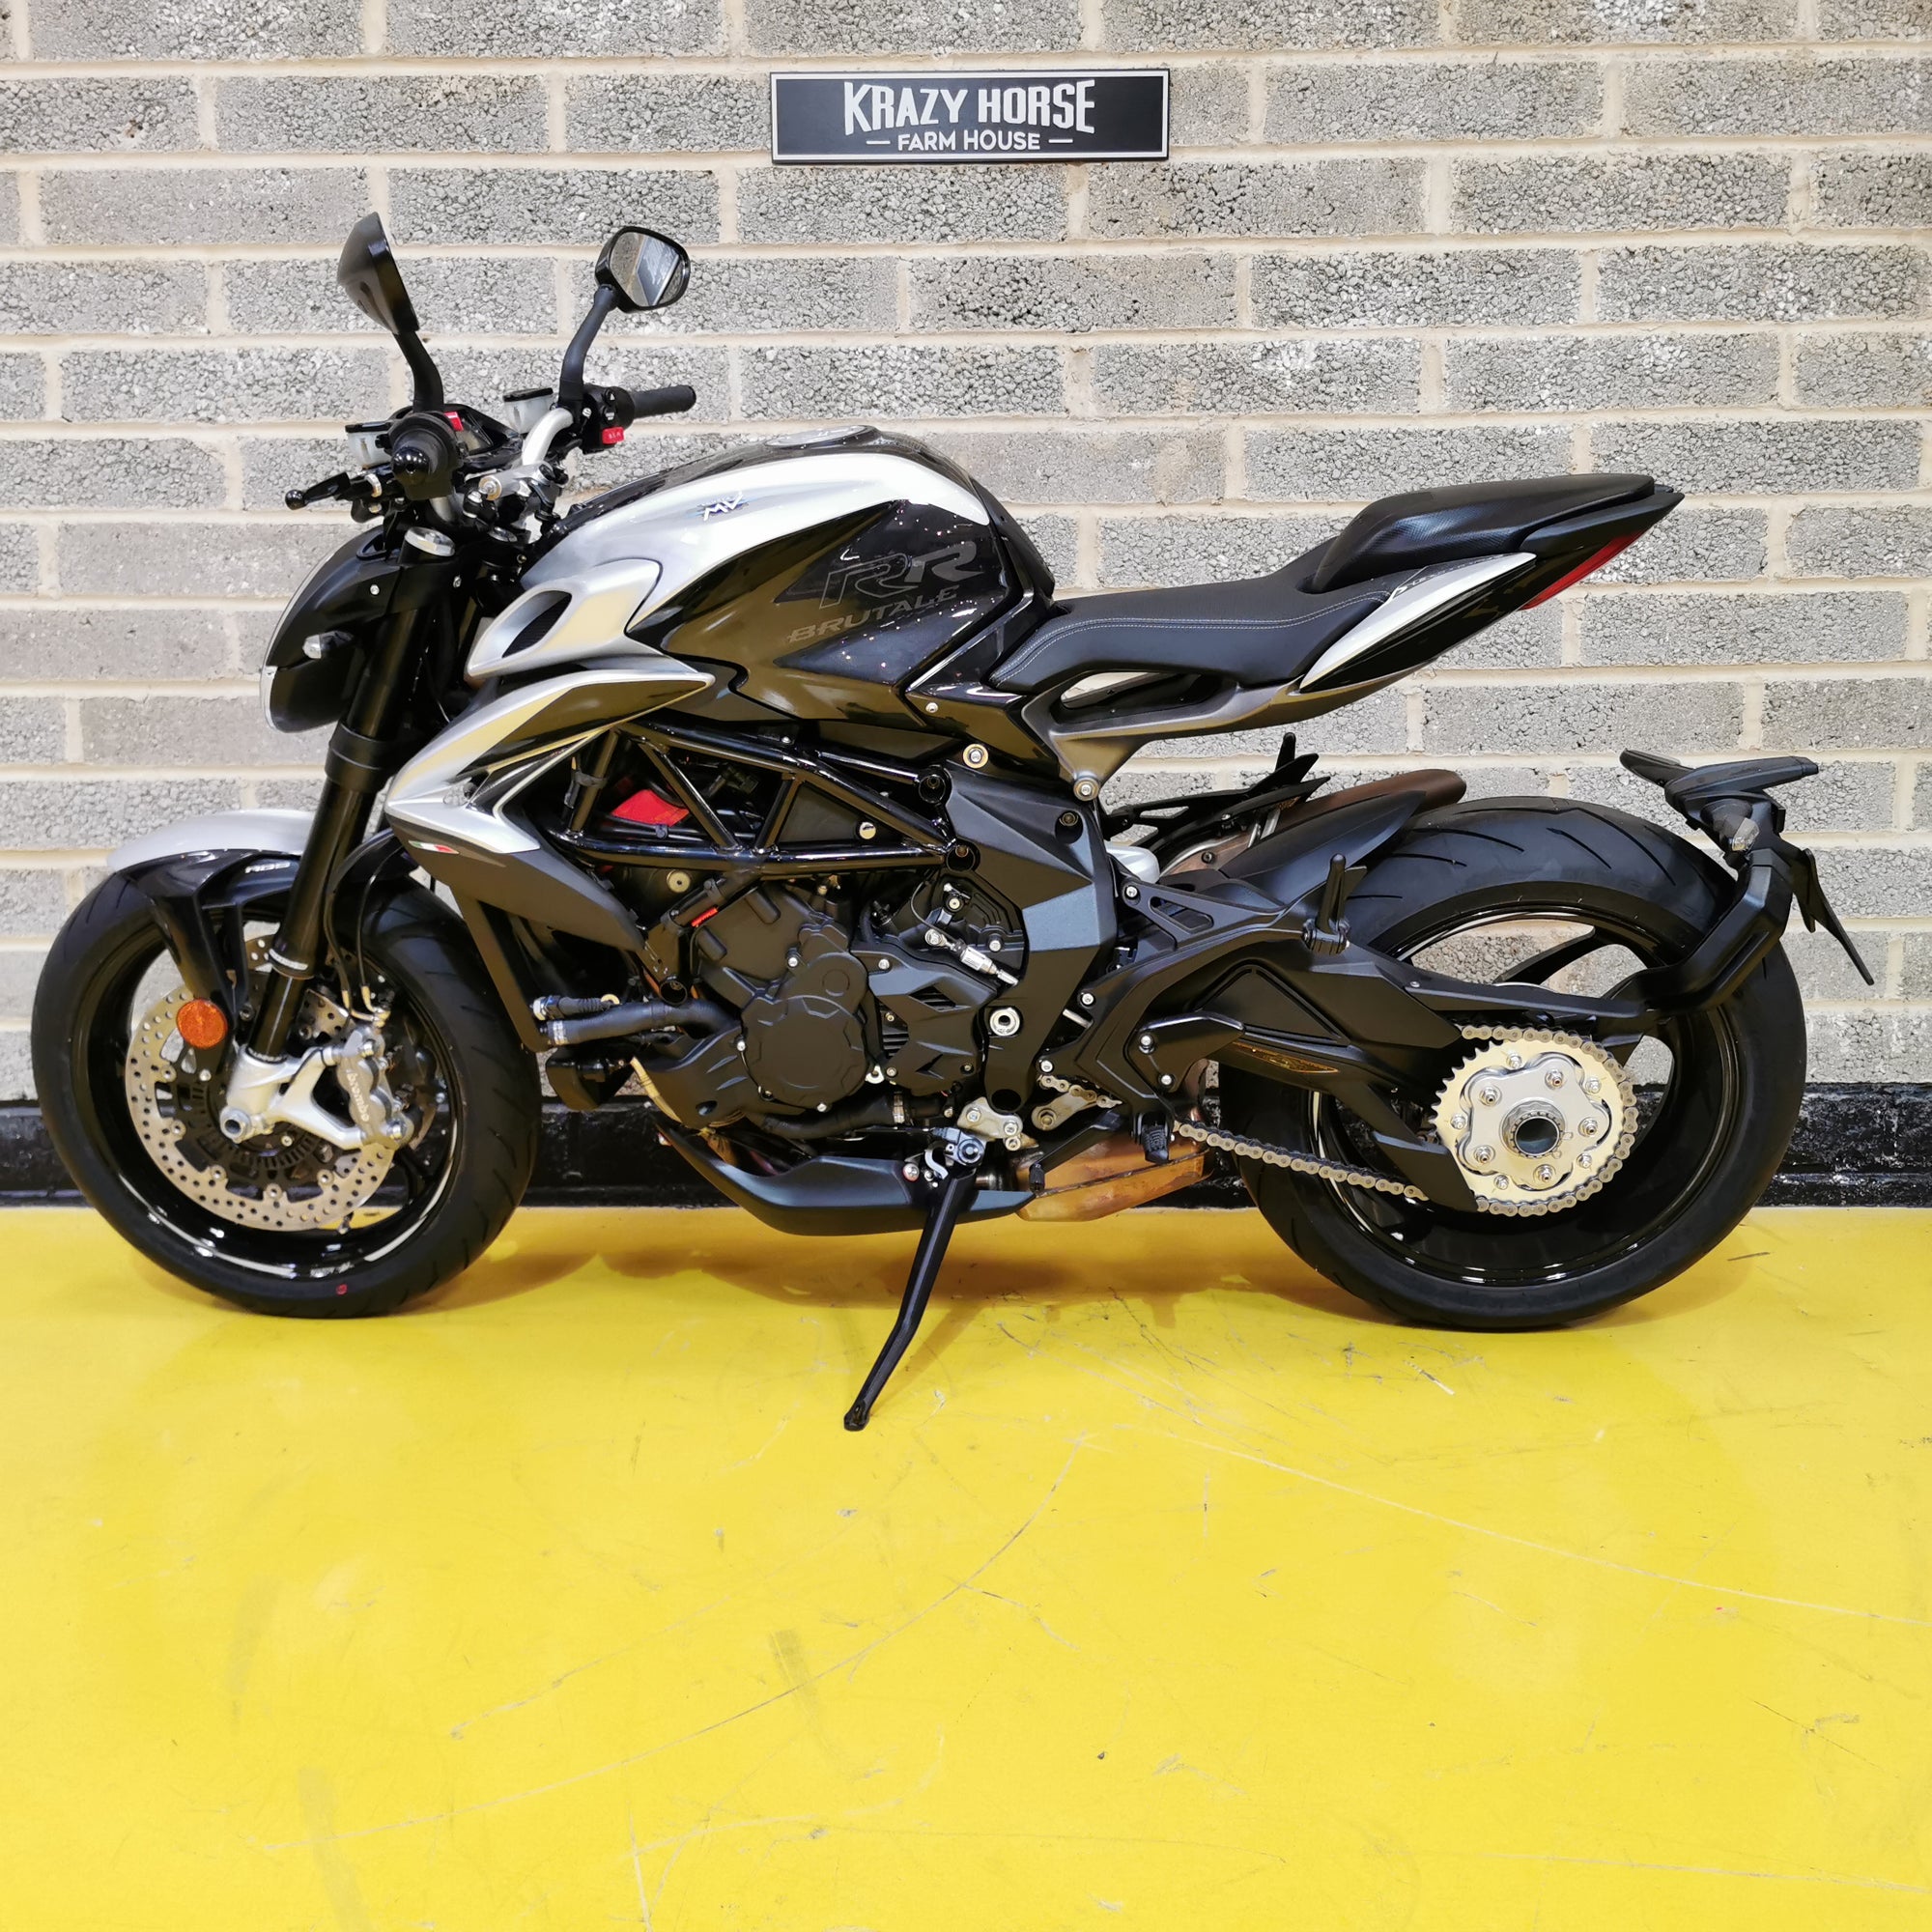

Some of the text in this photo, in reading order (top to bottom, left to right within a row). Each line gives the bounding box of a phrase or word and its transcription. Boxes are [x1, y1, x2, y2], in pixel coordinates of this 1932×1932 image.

[843, 79, 1095, 135] KRAZY HORSE
[897, 128, 1040, 151] FARM HOUSE
[819, 541, 984, 610] RR
[787, 584, 959, 642] BRUTALE
[346, 1068, 370, 1122] brembo
